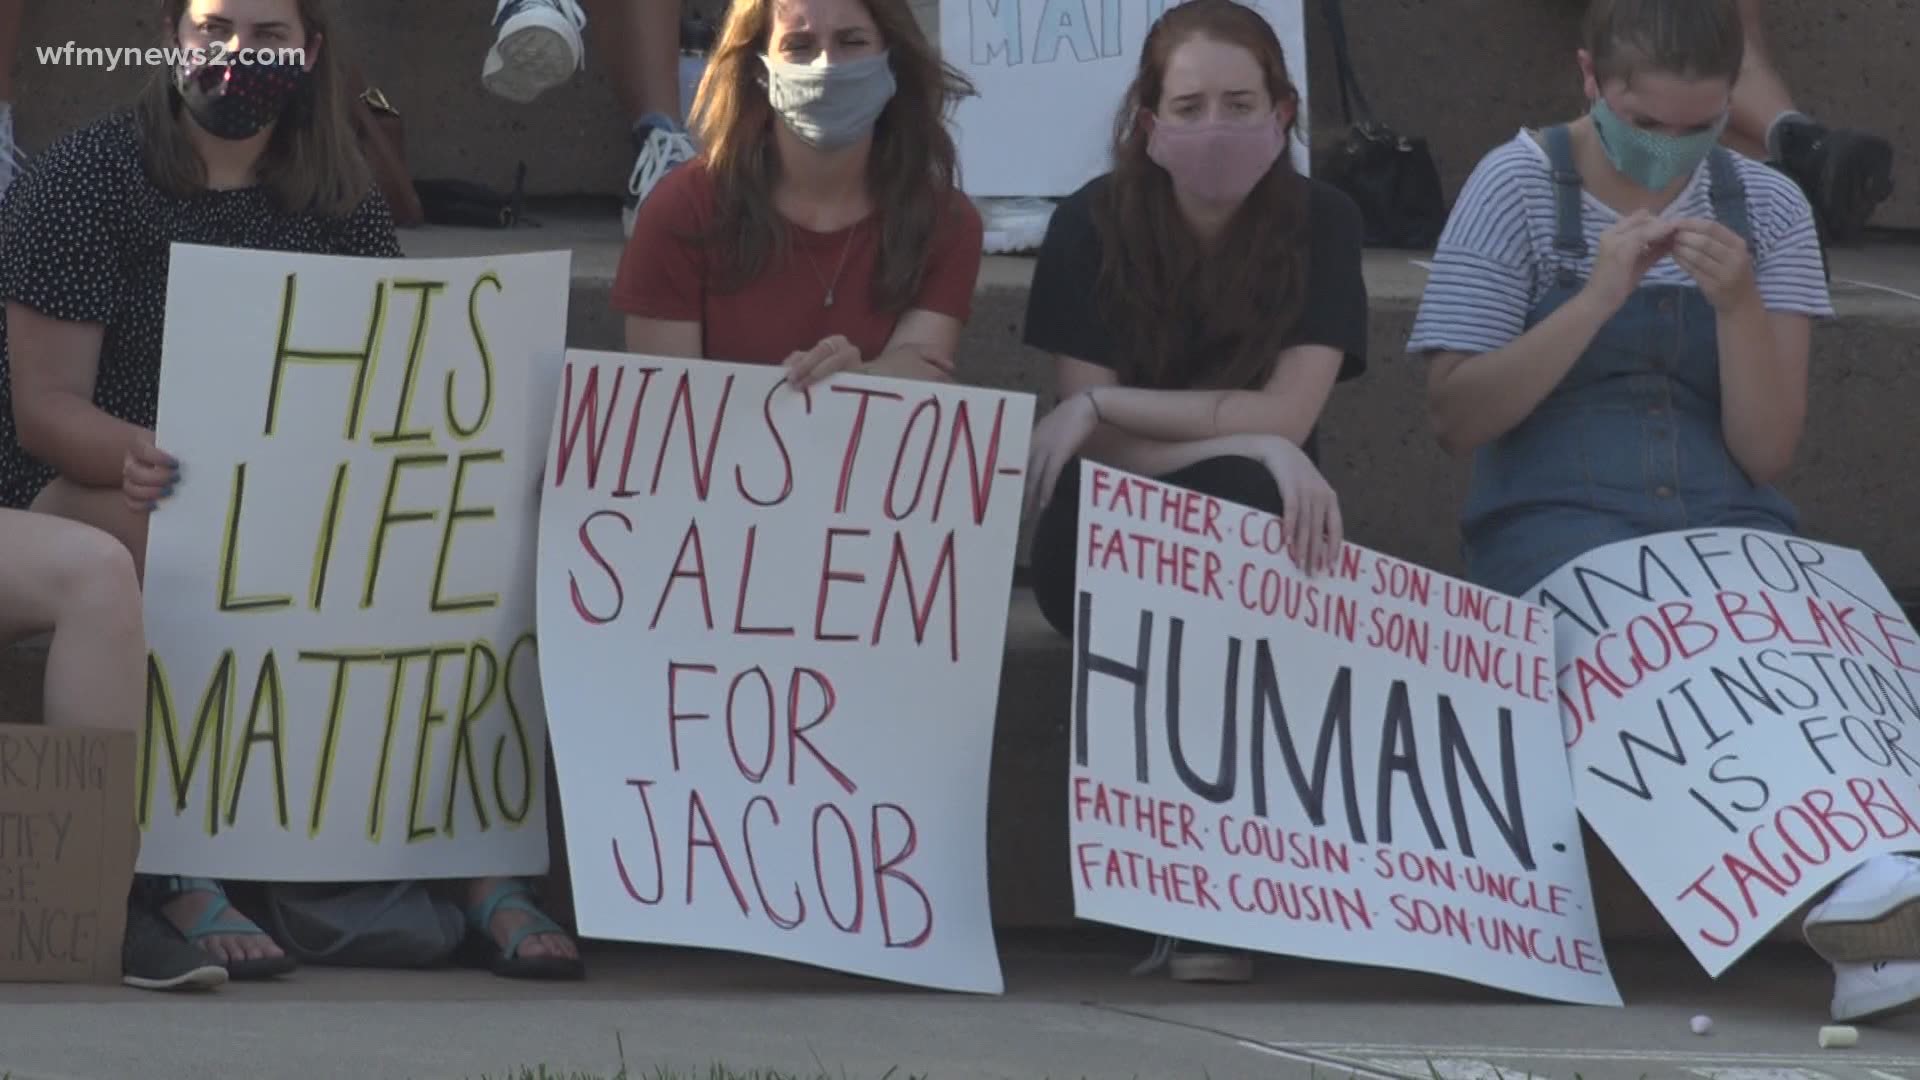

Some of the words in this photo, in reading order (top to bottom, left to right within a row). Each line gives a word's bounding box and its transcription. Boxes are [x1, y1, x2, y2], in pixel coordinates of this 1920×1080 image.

[969, 0, 1160, 67] MA
[264, 271, 502, 444] HIS
[555, 362, 1022, 526] WINSTON-
[219, 450, 503, 610] LIFE
[569, 509, 958, 661] SALEM
[1092, 468, 1223, 543] FATHER
[1239, 511, 1361, 581] CON
[1371, 557, 1431, 608] SON
[1444, 581, 1545, 645] UNCLE
[1685, 532, 1880, 615] FOR
[1088, 522, 1224, 600] FATHER
[1238, 562, 1357, 643] COUSIN
[1366, 606, 1429, 665] SON
[1442, 629, 1550, 703] UNCLE
[1557, 602, 1718, 749] JACOB
[1716, 590, 1920, 674] BLAKE
[136, 632, 537, 842] MATTERS
[668, 660, 857, 794] FOR
[1075, 590, 1567, 871] HUMAN.
[1588, 649, 1920, 800] WINSTON
[1688, 754, 1770, 833] IS
[1798, 715, 1920, 776] FOR
[612, 780, 933, 948] JACOB
[1074, 777, 1205, 851] FATHER
[1219, 814, 1350, 874] COUSIN
[1374, 849, 1457, 891] SON
[1464, 865, 1573, 917] UNCLE
[1077, 842, 1222, 911] FATHER
[1228, 873, 1374, 931] COUSIN
[1389, 894, 1473, 945] SON
[1477, 915, 1603, 976] UNCLE
[1677, 789, 1868, 947] JACOB
